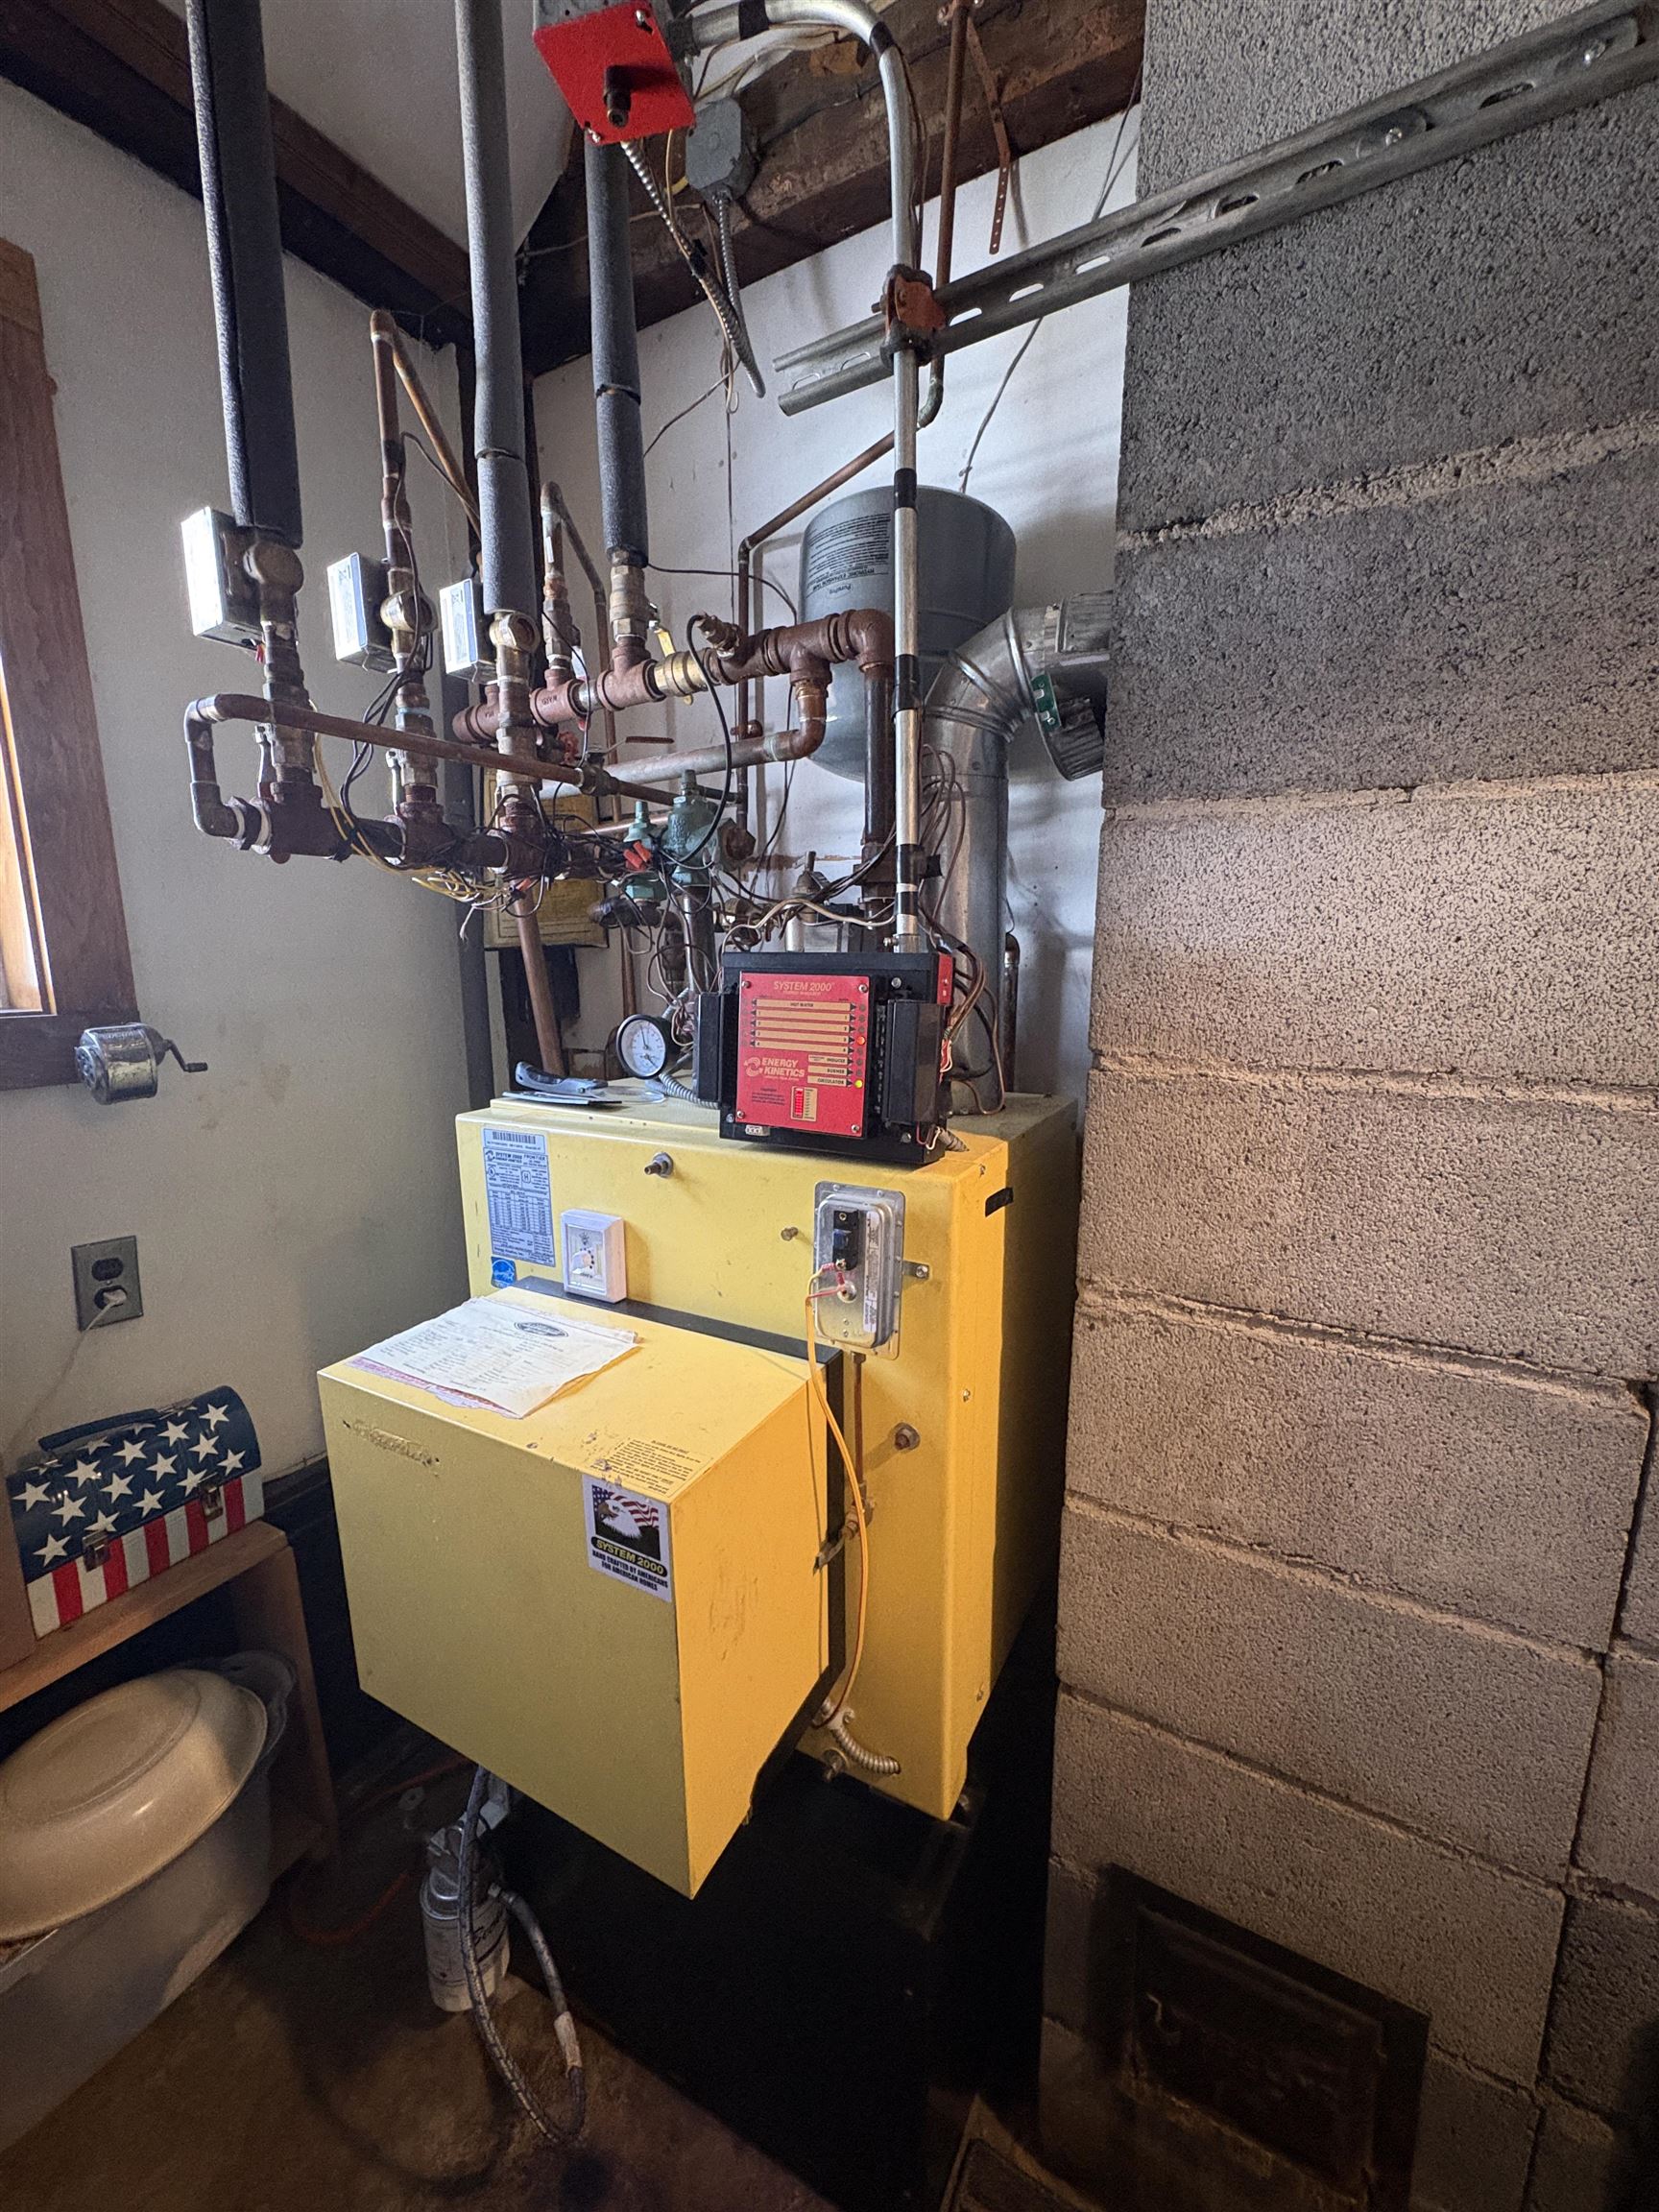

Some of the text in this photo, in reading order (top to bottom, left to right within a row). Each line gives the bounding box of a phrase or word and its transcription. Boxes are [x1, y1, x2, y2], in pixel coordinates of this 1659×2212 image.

[822, 573, 847, 587] EXPANSION
[774, 980, 832, 992] SYSTEM 2000
[761, 1057, 799, 1068] ENERGY
[763, 1066, 805, 1077] KINETICS
[596, 1539, 664, 1575] SYSTEM 2000
[592, 1549, 668, 1588] HAND CRAFTED BY AMERICANS
[601, 1560, 659, 1591] FOR AMERICAN HOMES
